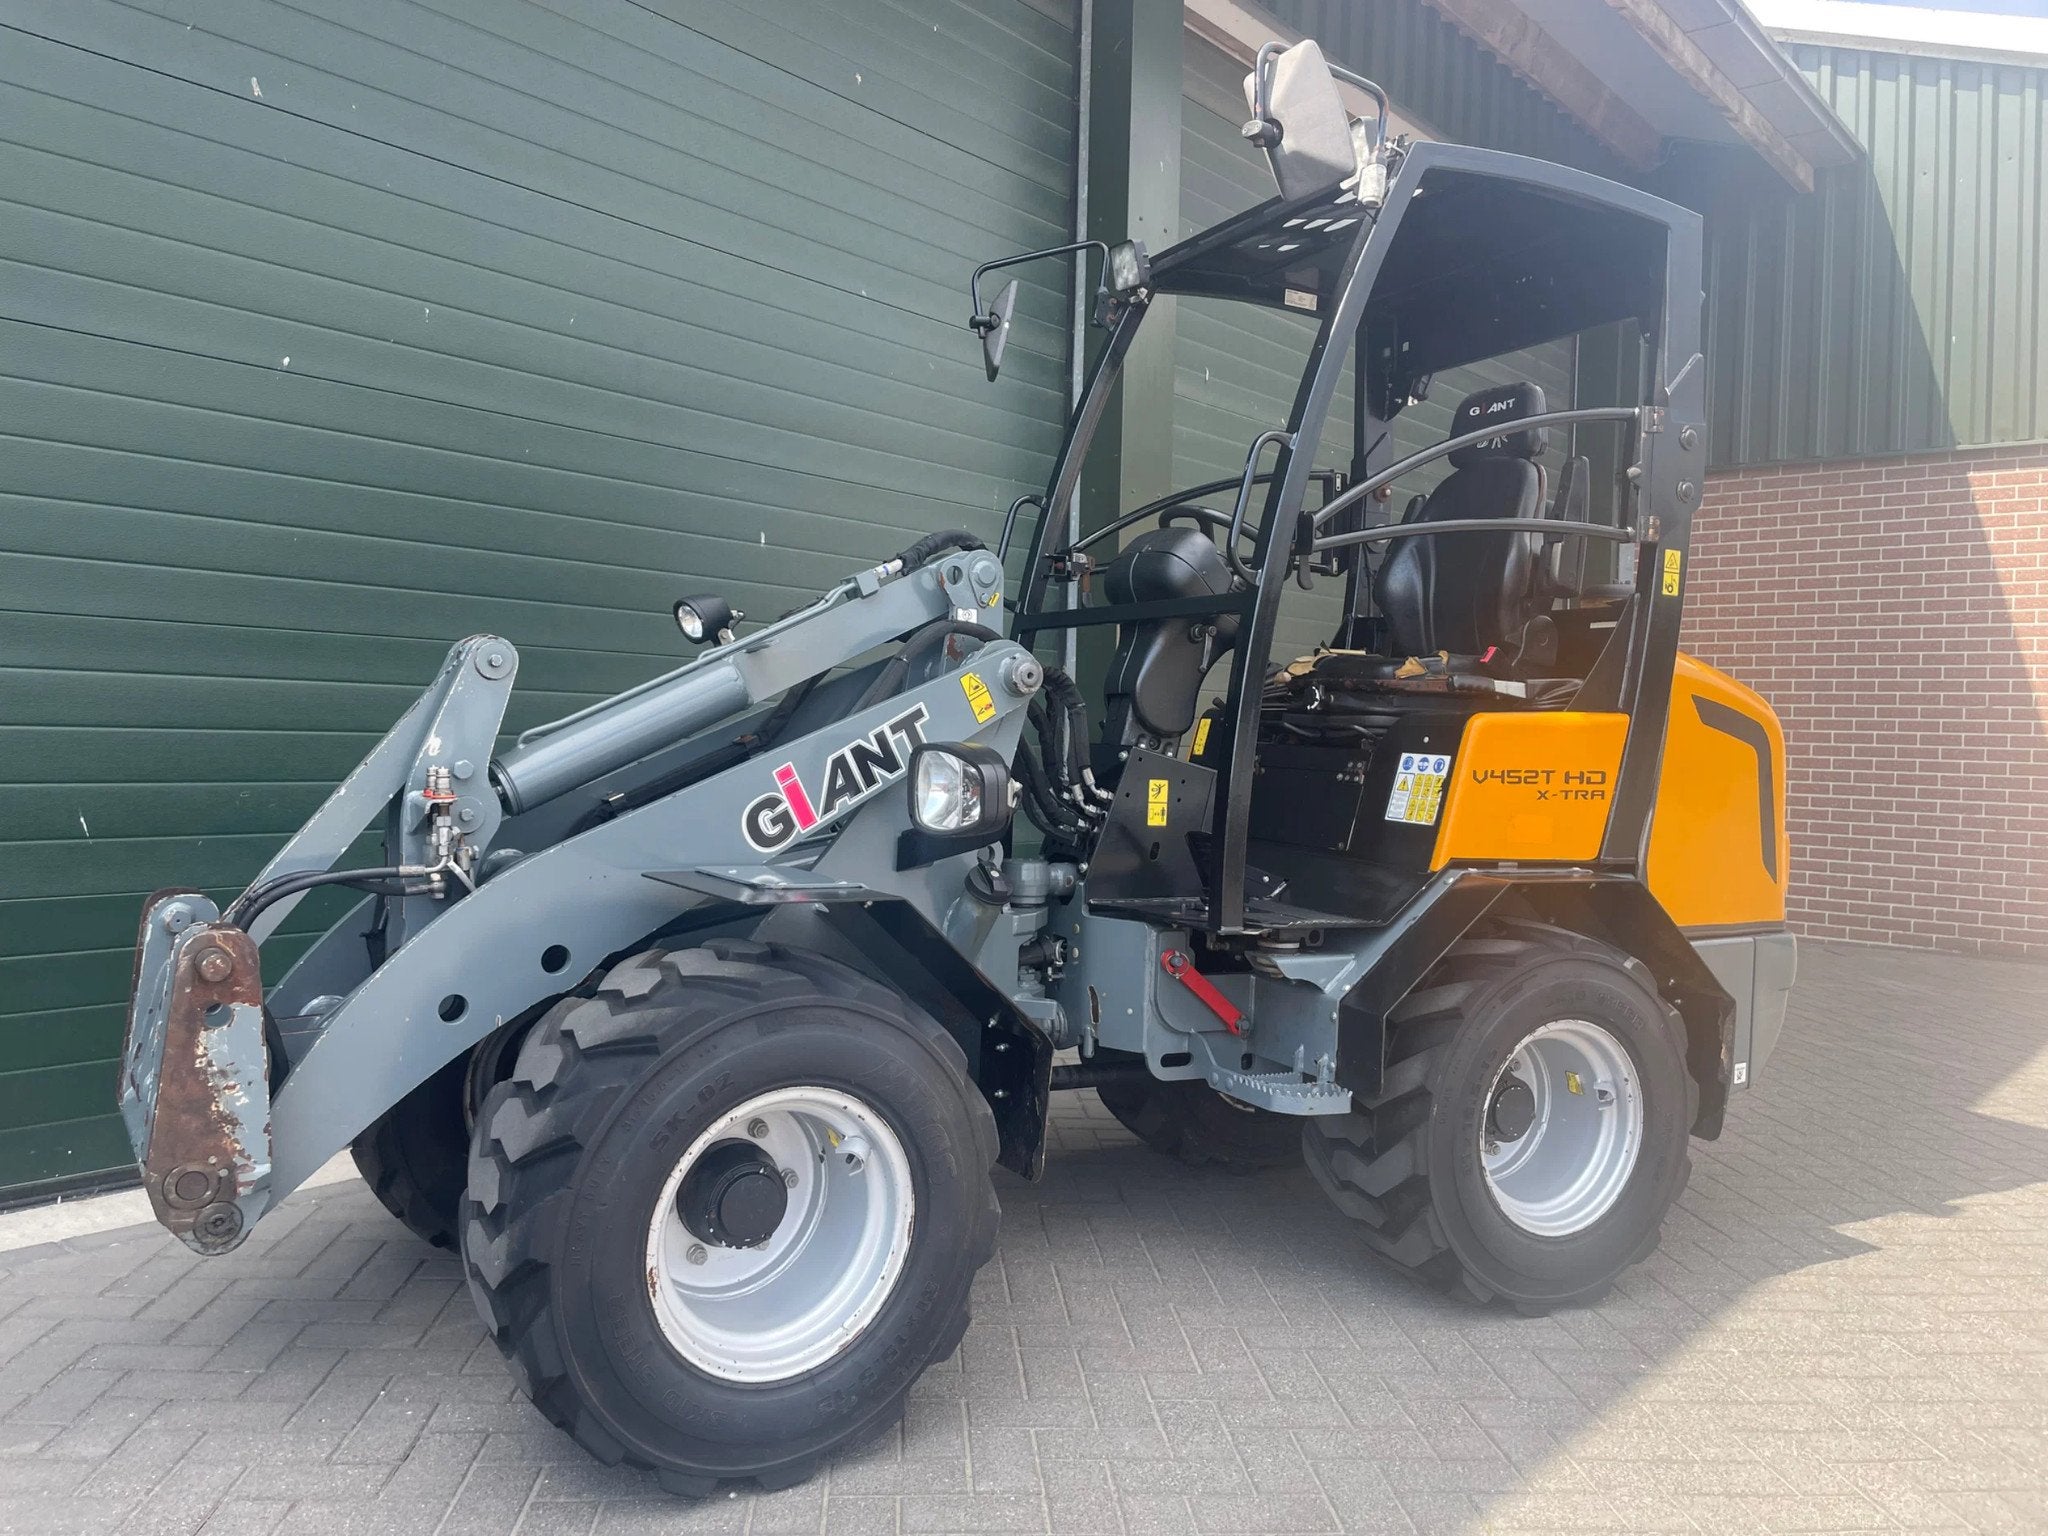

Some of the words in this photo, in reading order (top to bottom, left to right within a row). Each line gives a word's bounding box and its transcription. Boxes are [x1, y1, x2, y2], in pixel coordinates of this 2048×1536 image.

[1472, 769, 1556, 785] V452T
[1564, 770, 1607, 785] HD
[1536, 790, 1605, 801] X-TRA
